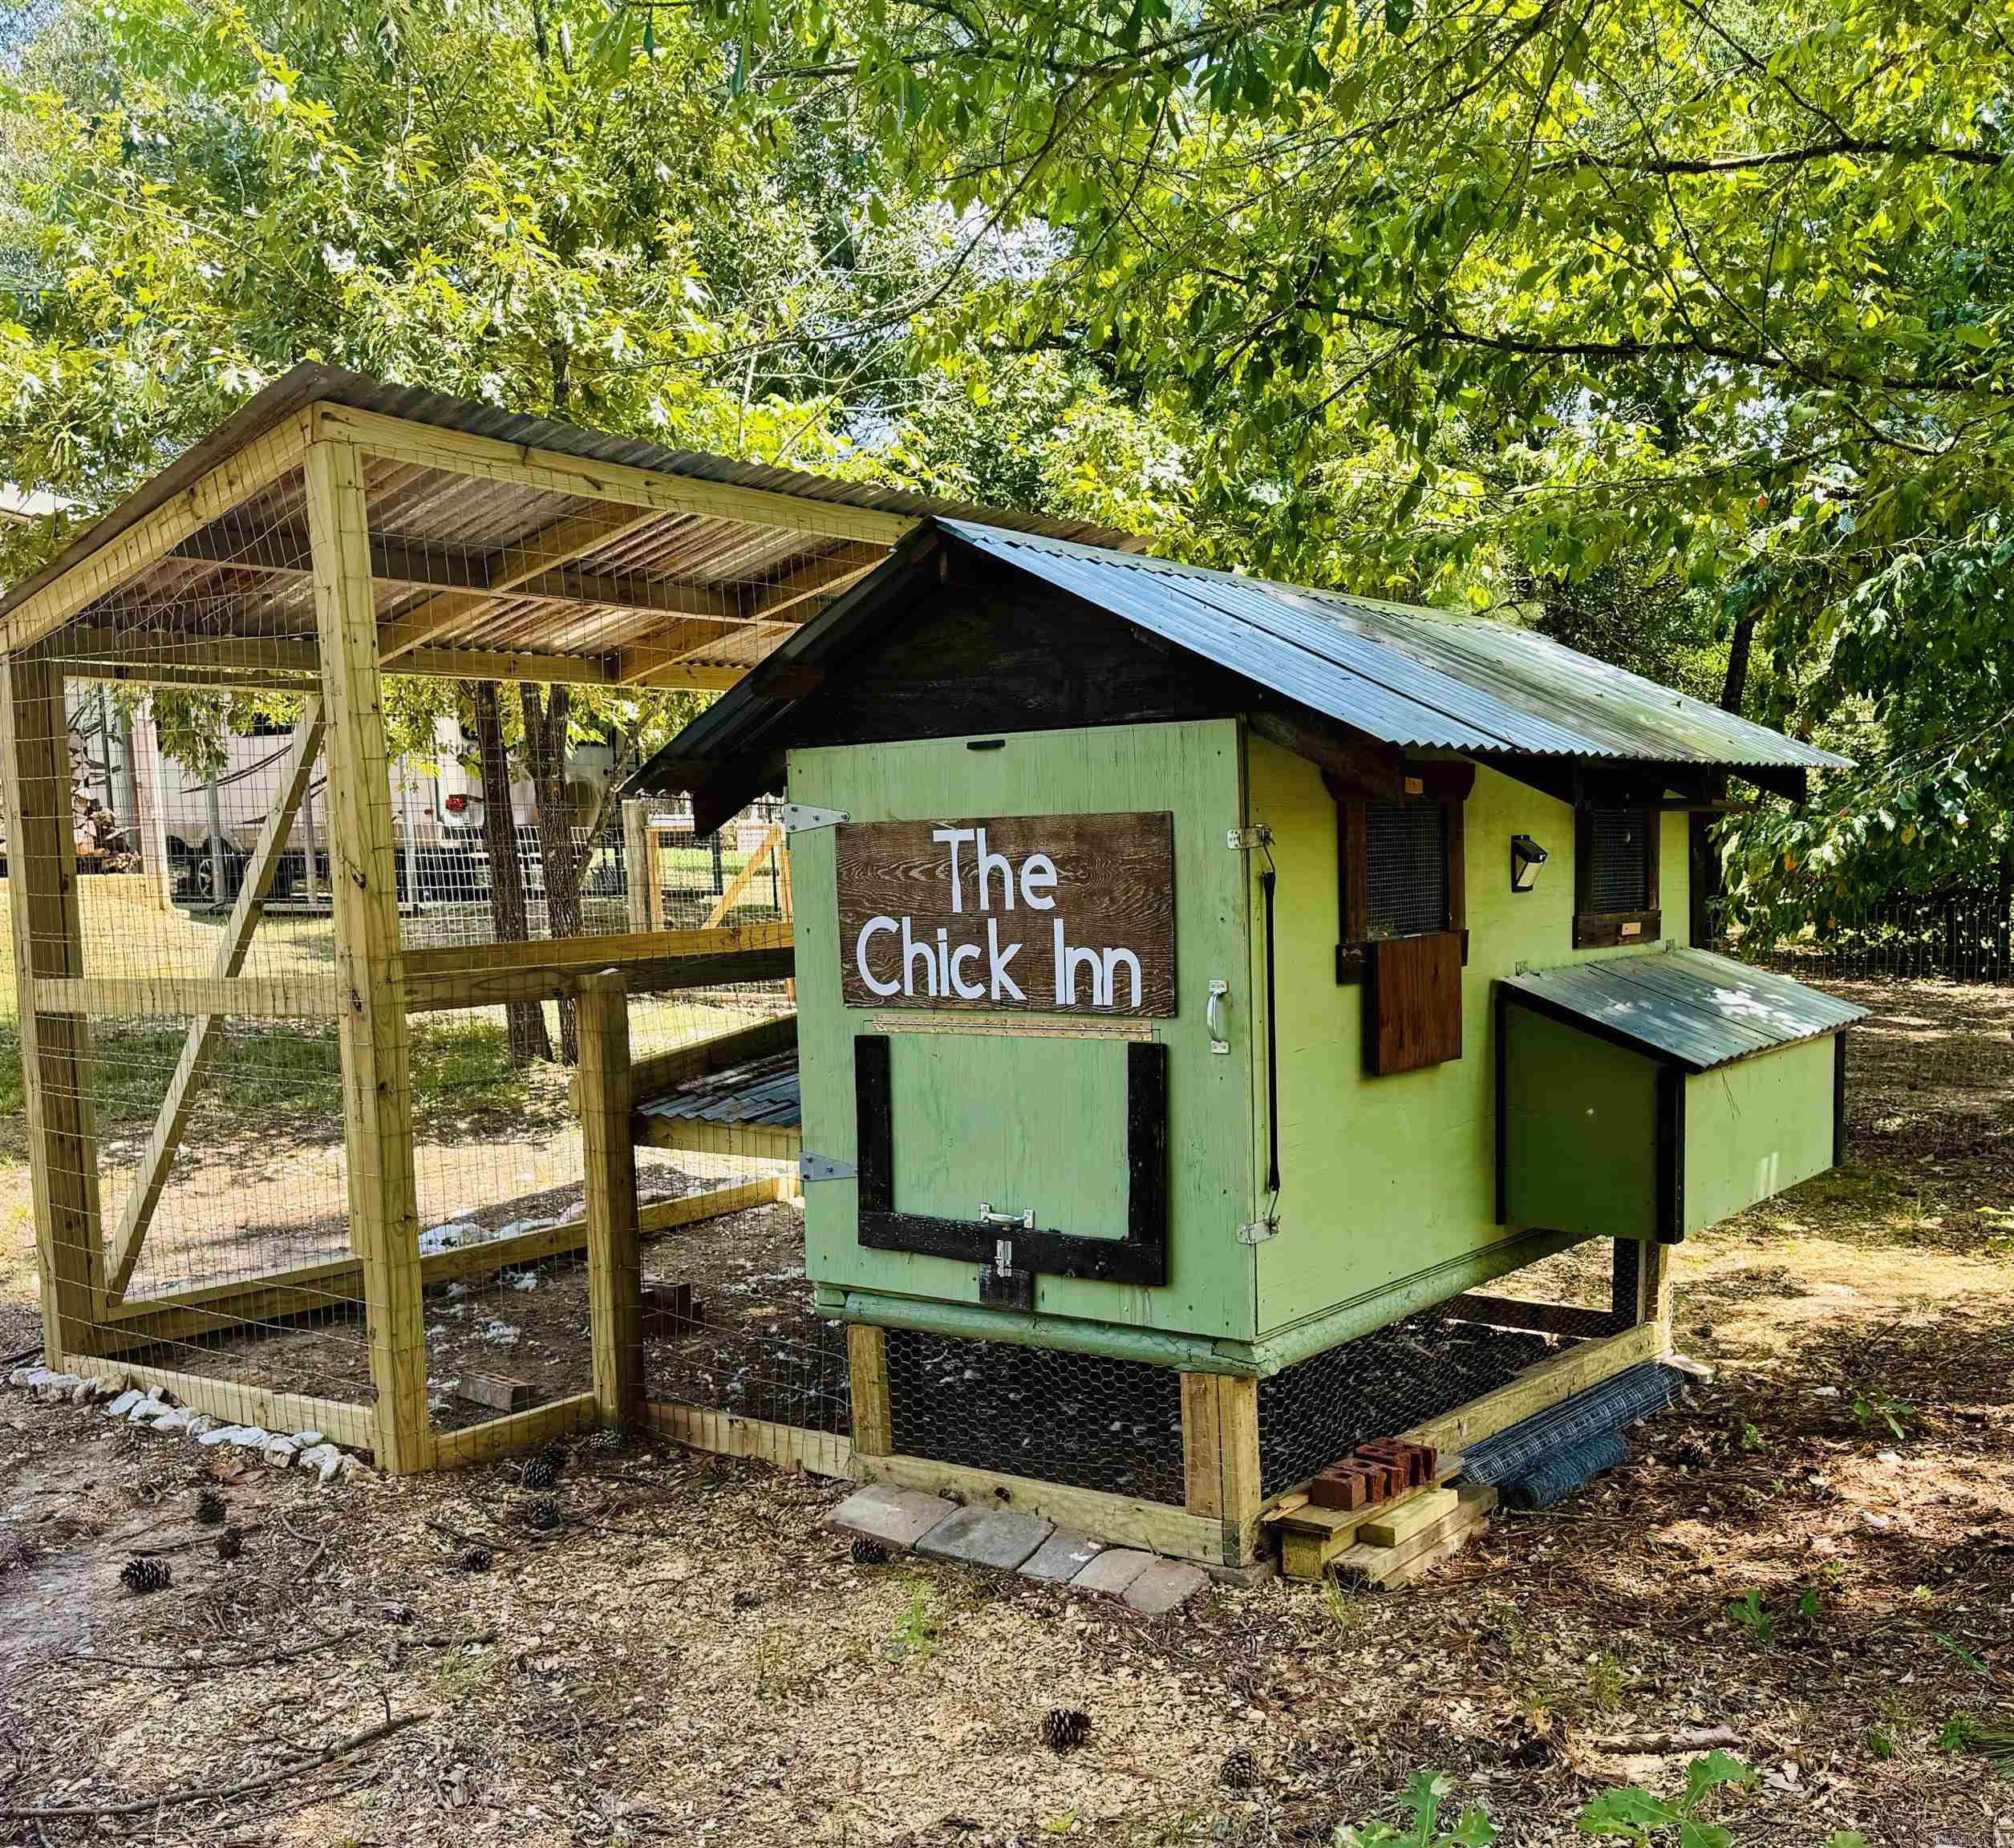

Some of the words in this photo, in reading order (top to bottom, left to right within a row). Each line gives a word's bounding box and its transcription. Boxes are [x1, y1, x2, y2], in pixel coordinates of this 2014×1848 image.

[933, 828, 1058, 913] The
[856, 915, 1027, 1000] Chick
[1053, 918, 1141, 1007] Inn
